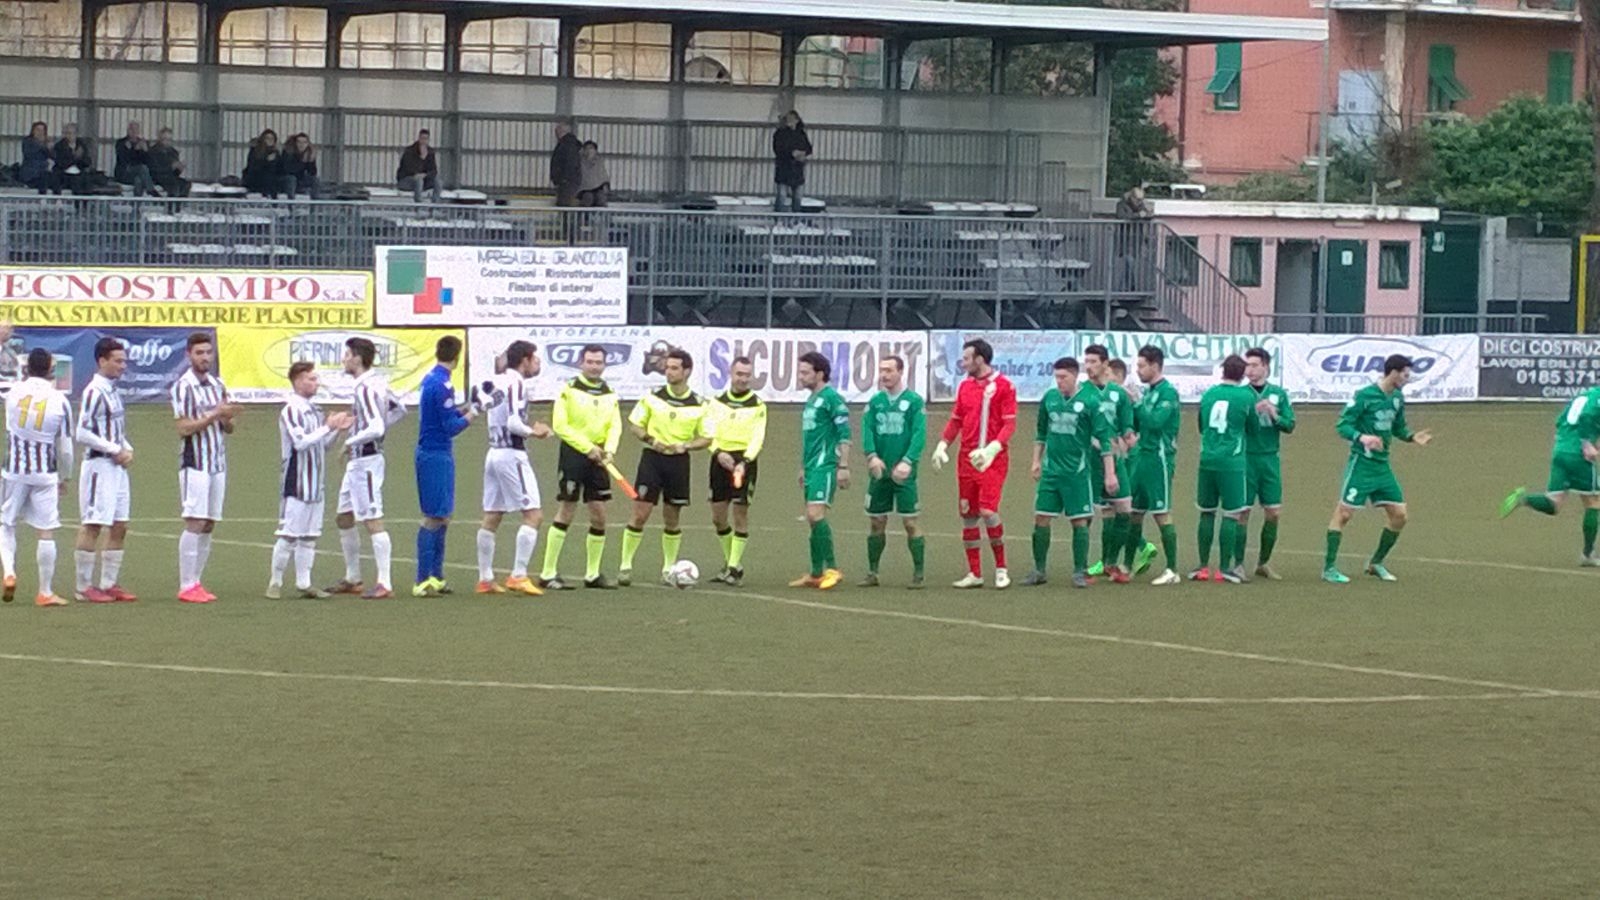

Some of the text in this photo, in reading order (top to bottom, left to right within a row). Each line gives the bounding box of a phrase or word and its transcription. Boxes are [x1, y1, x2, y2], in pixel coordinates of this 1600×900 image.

[0, 273, 320, 300] ECNOSTAMPO
[71, 306, 150, 323] STAMPI
[156, 307, 250, 324] MATERIE
[255, 307, 367, 325] PLASTICHE
[528, 328, 652, 337] AUTOFFICINA
[1483, 339, 1527, 355] DIECI
[1321, 354, 1436, 374] ELIAO
[1480, 358, 1536, 369] LAVORI
[1538, 359, 1576, 369] EDILI
[1516, 370, 1561, 385] 0185
[17, 395, 48, 432] 11
[1209, 400, 1229, 434] 4
[1346, 487, 1358, 503] 2
